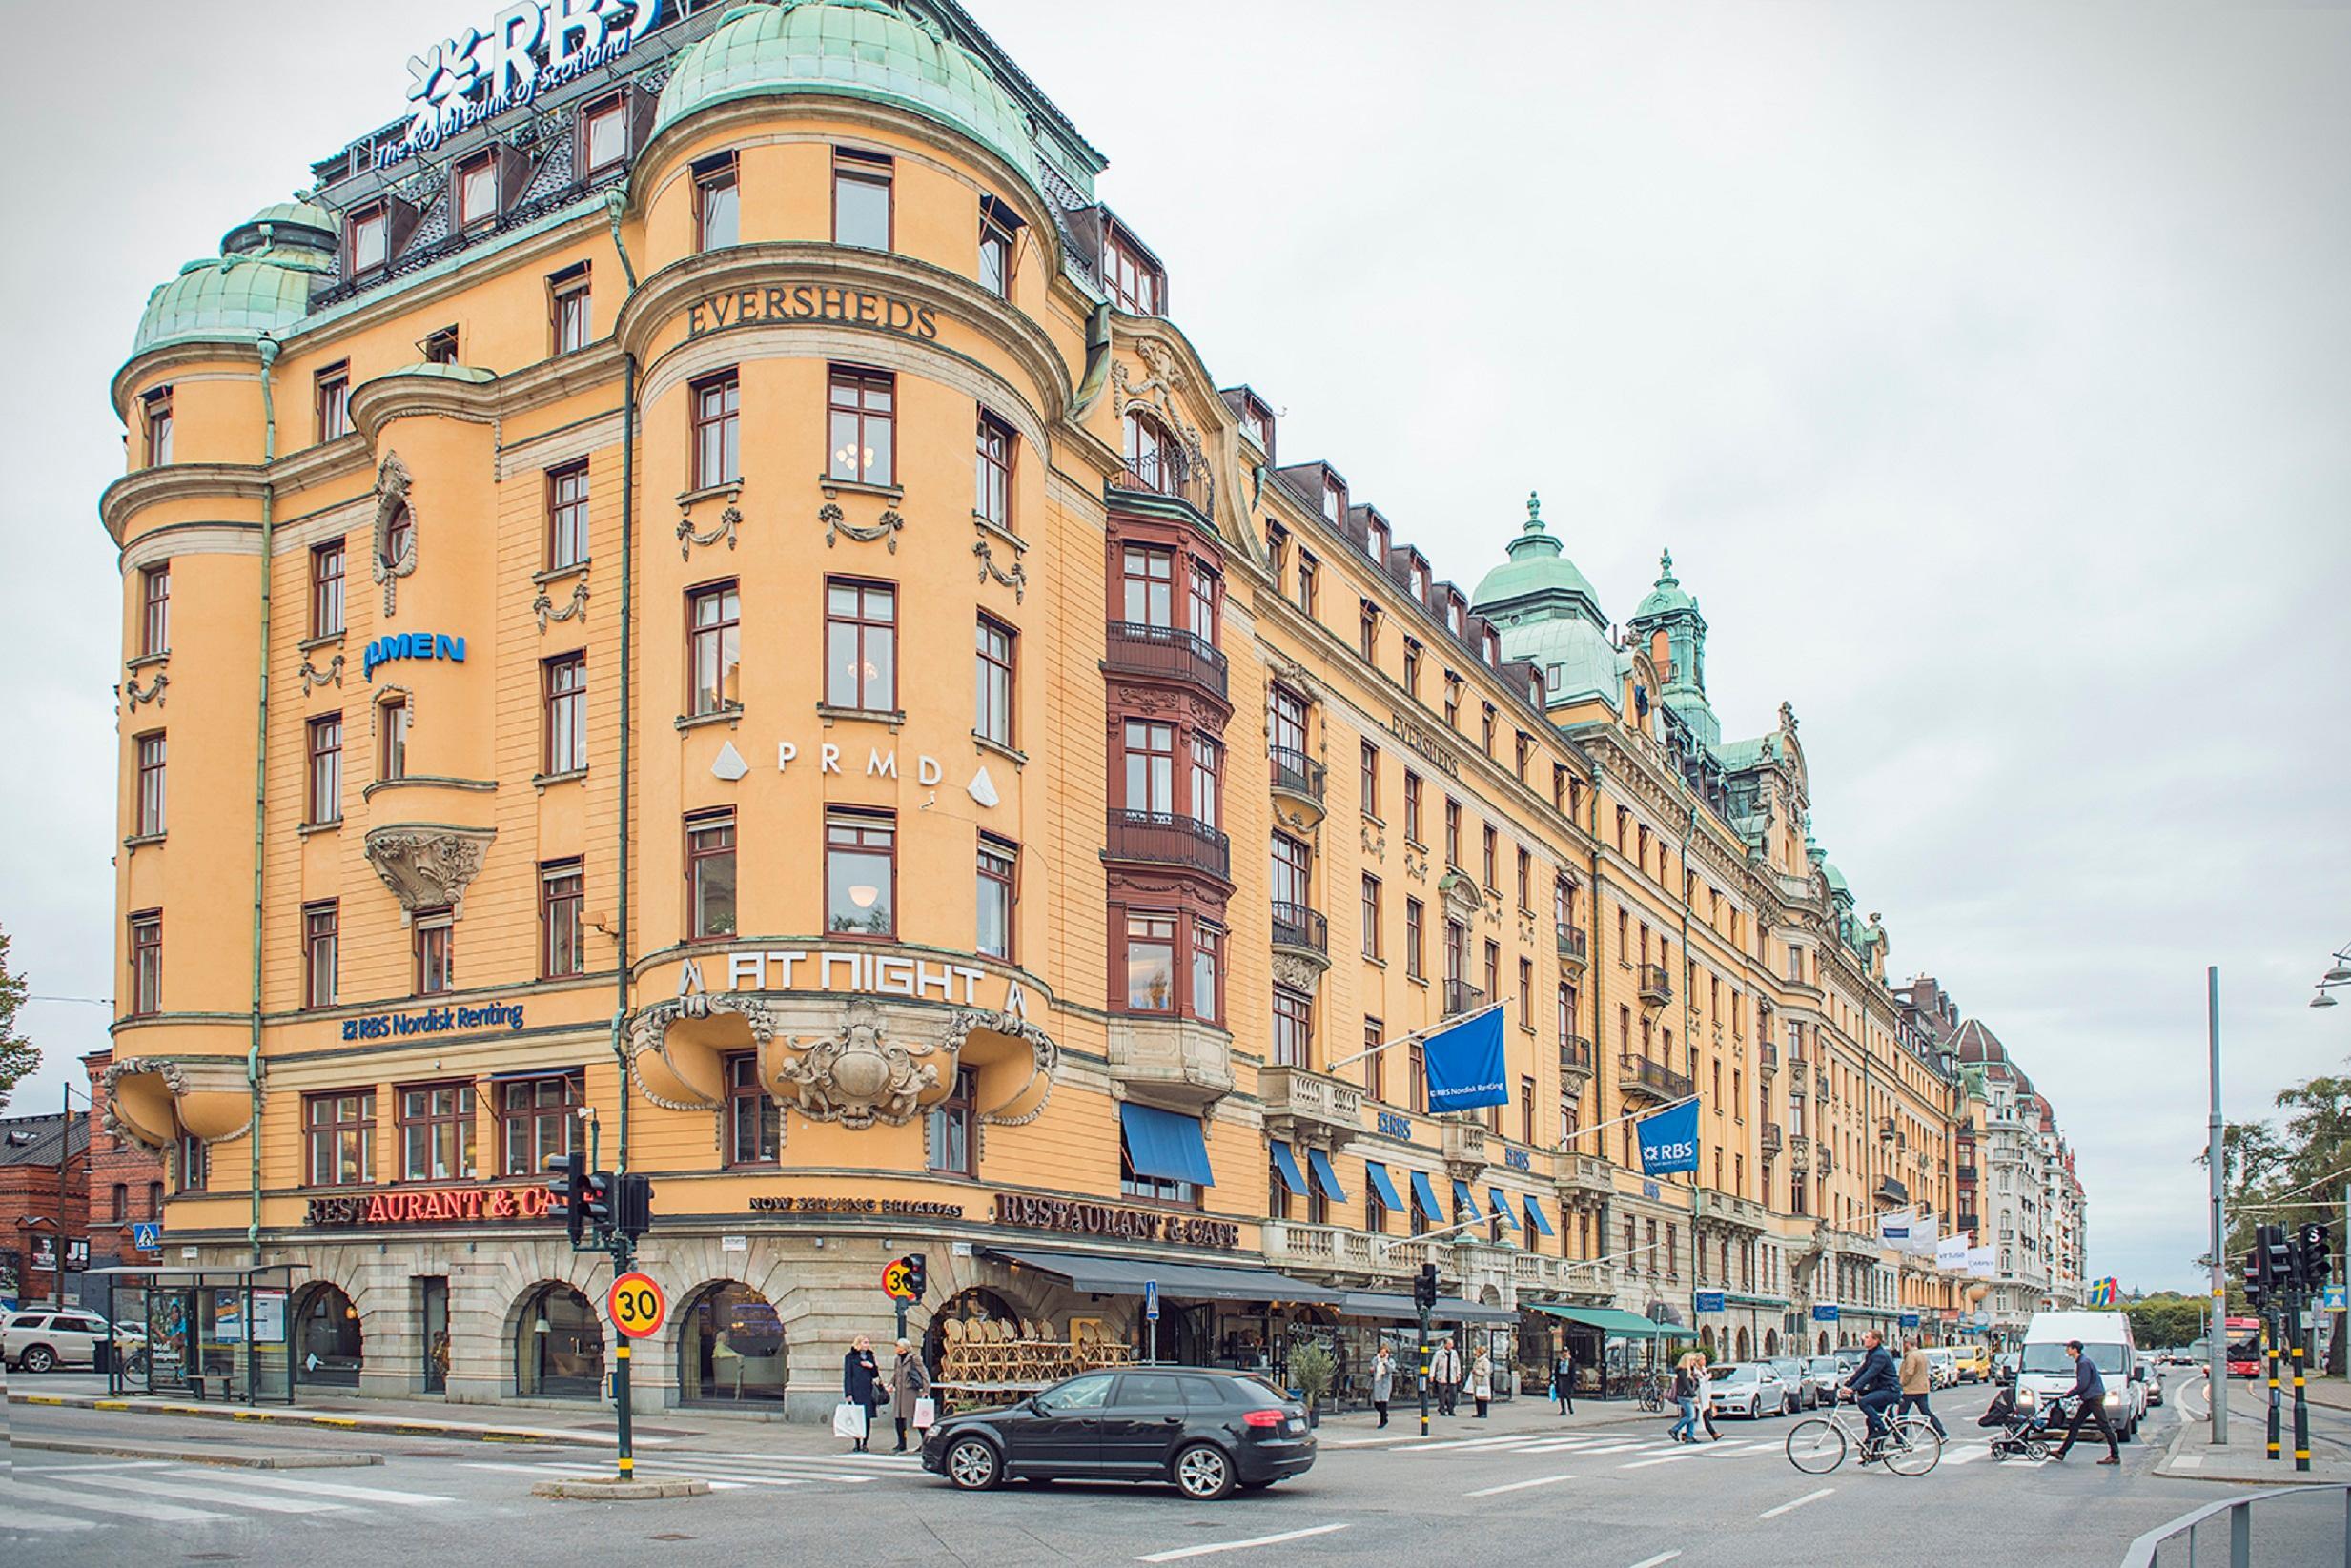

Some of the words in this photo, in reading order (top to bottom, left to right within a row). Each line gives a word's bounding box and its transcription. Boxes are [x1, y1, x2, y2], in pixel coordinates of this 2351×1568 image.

[376, 140, 408, 168] The
[411, 106, 463, 152] Royal
[464, 88, 512, 126] Bank
[516, 77, 538, 104] of
[540, 27, 632, 91] Scotland
[687, 286, 937, 338] EVERSHEDS
[1393, 714, 1459, 778] EVERSHEDS
[728, 951, 807, 990] AT
[358, 1014, 390, 1039] RBS
[393, 1007, 455, 1035] Nordisk
[457, 1001, 523, 1029] Renting
[1389, 1115, 1411, 1140] RBS
[1661, 1141, 1693, 1159] RBS
[305, 1190, 482, 1223] RESTAURANT
[491, 1189, 515, 1218] &
[749, 1196, 793, 1210] NOW
[997, 1194, 1162, 1239] RESTAURANT
[1166, 1215, 1188, 1241] &
[618, 1290, 657, 1321] 30
